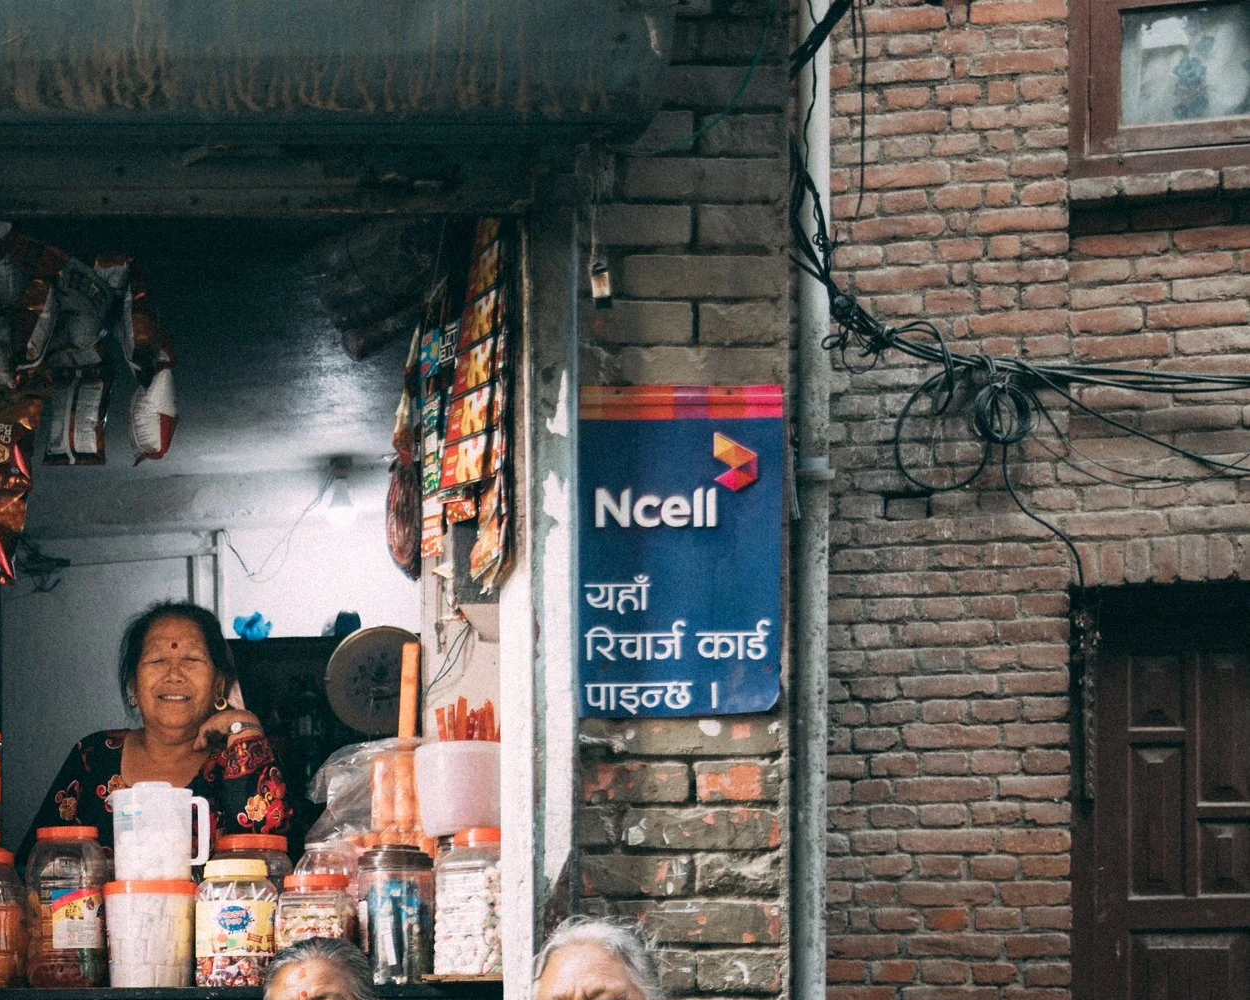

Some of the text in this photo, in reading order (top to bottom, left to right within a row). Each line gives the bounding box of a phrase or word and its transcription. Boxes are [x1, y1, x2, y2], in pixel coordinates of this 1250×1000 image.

[594, 487, 717, 528] Ncell
[584, 575, 650, 614] यहाँ
[584, 619, 771, 661] रिचार्ज कार्ड
[584, 682, 692, 714] पाइन्छ
